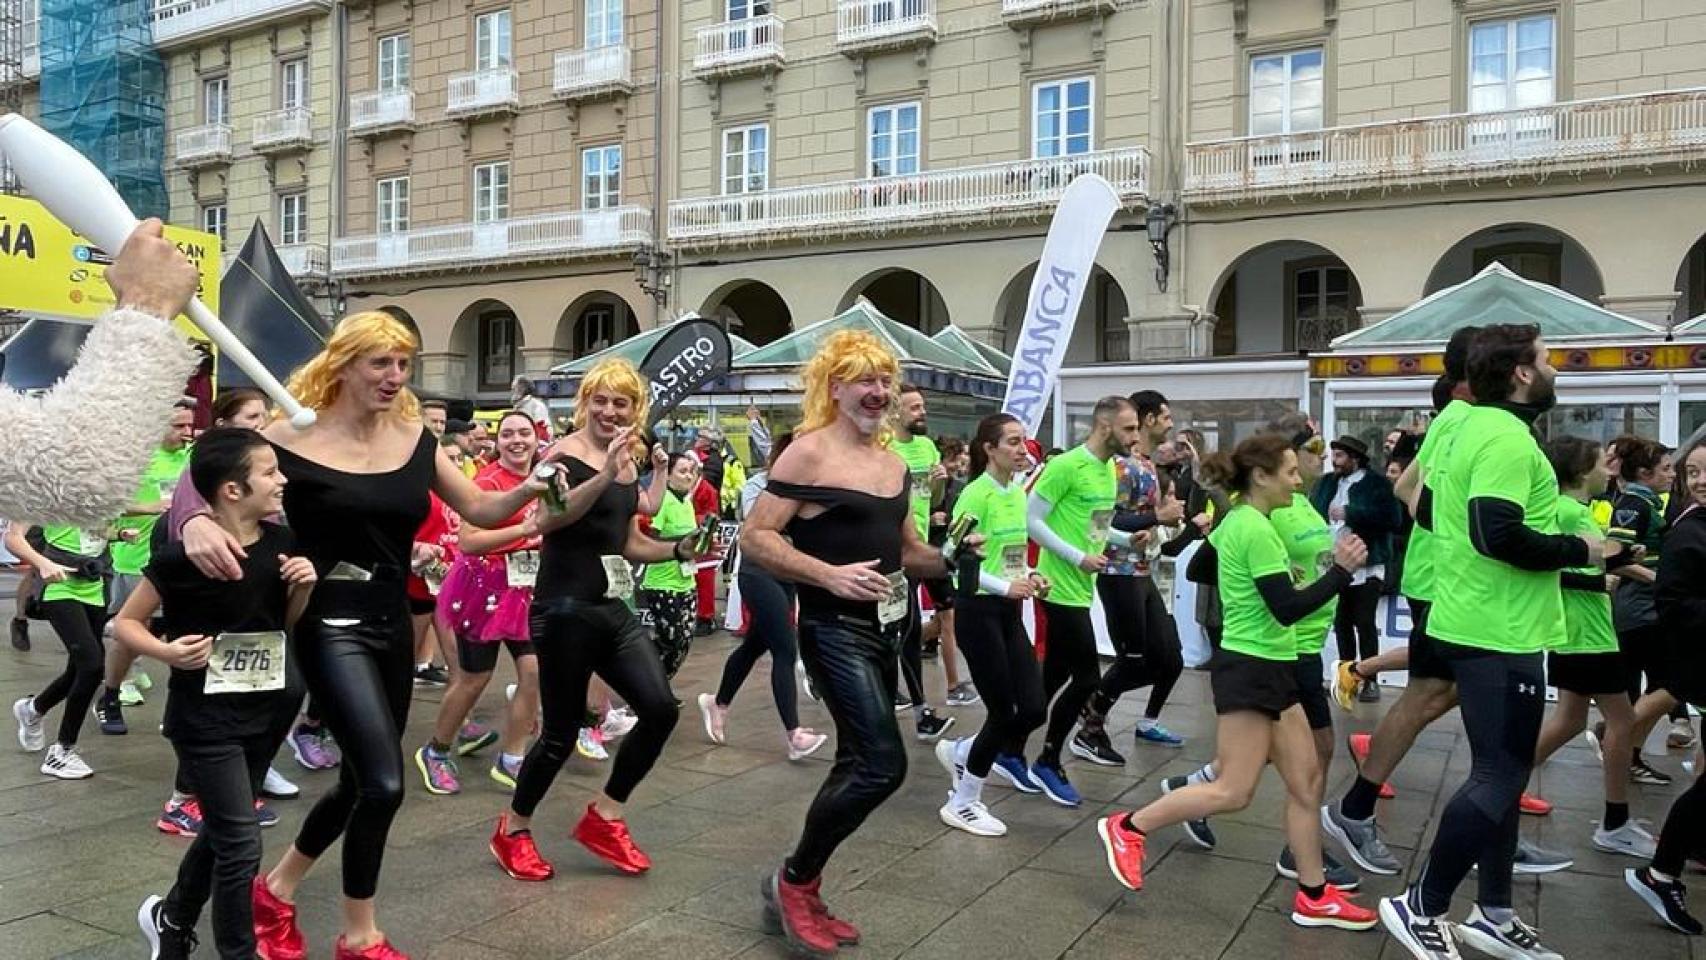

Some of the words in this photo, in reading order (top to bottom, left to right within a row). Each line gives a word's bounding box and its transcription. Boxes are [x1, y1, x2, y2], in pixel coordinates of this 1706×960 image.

[176, 241, 205, 259] SAN
[1007, 265, 1076, 426] ABANCA
[649, 337, 714, 404] ASTRO
[222, 649, 271, 671] 2676
